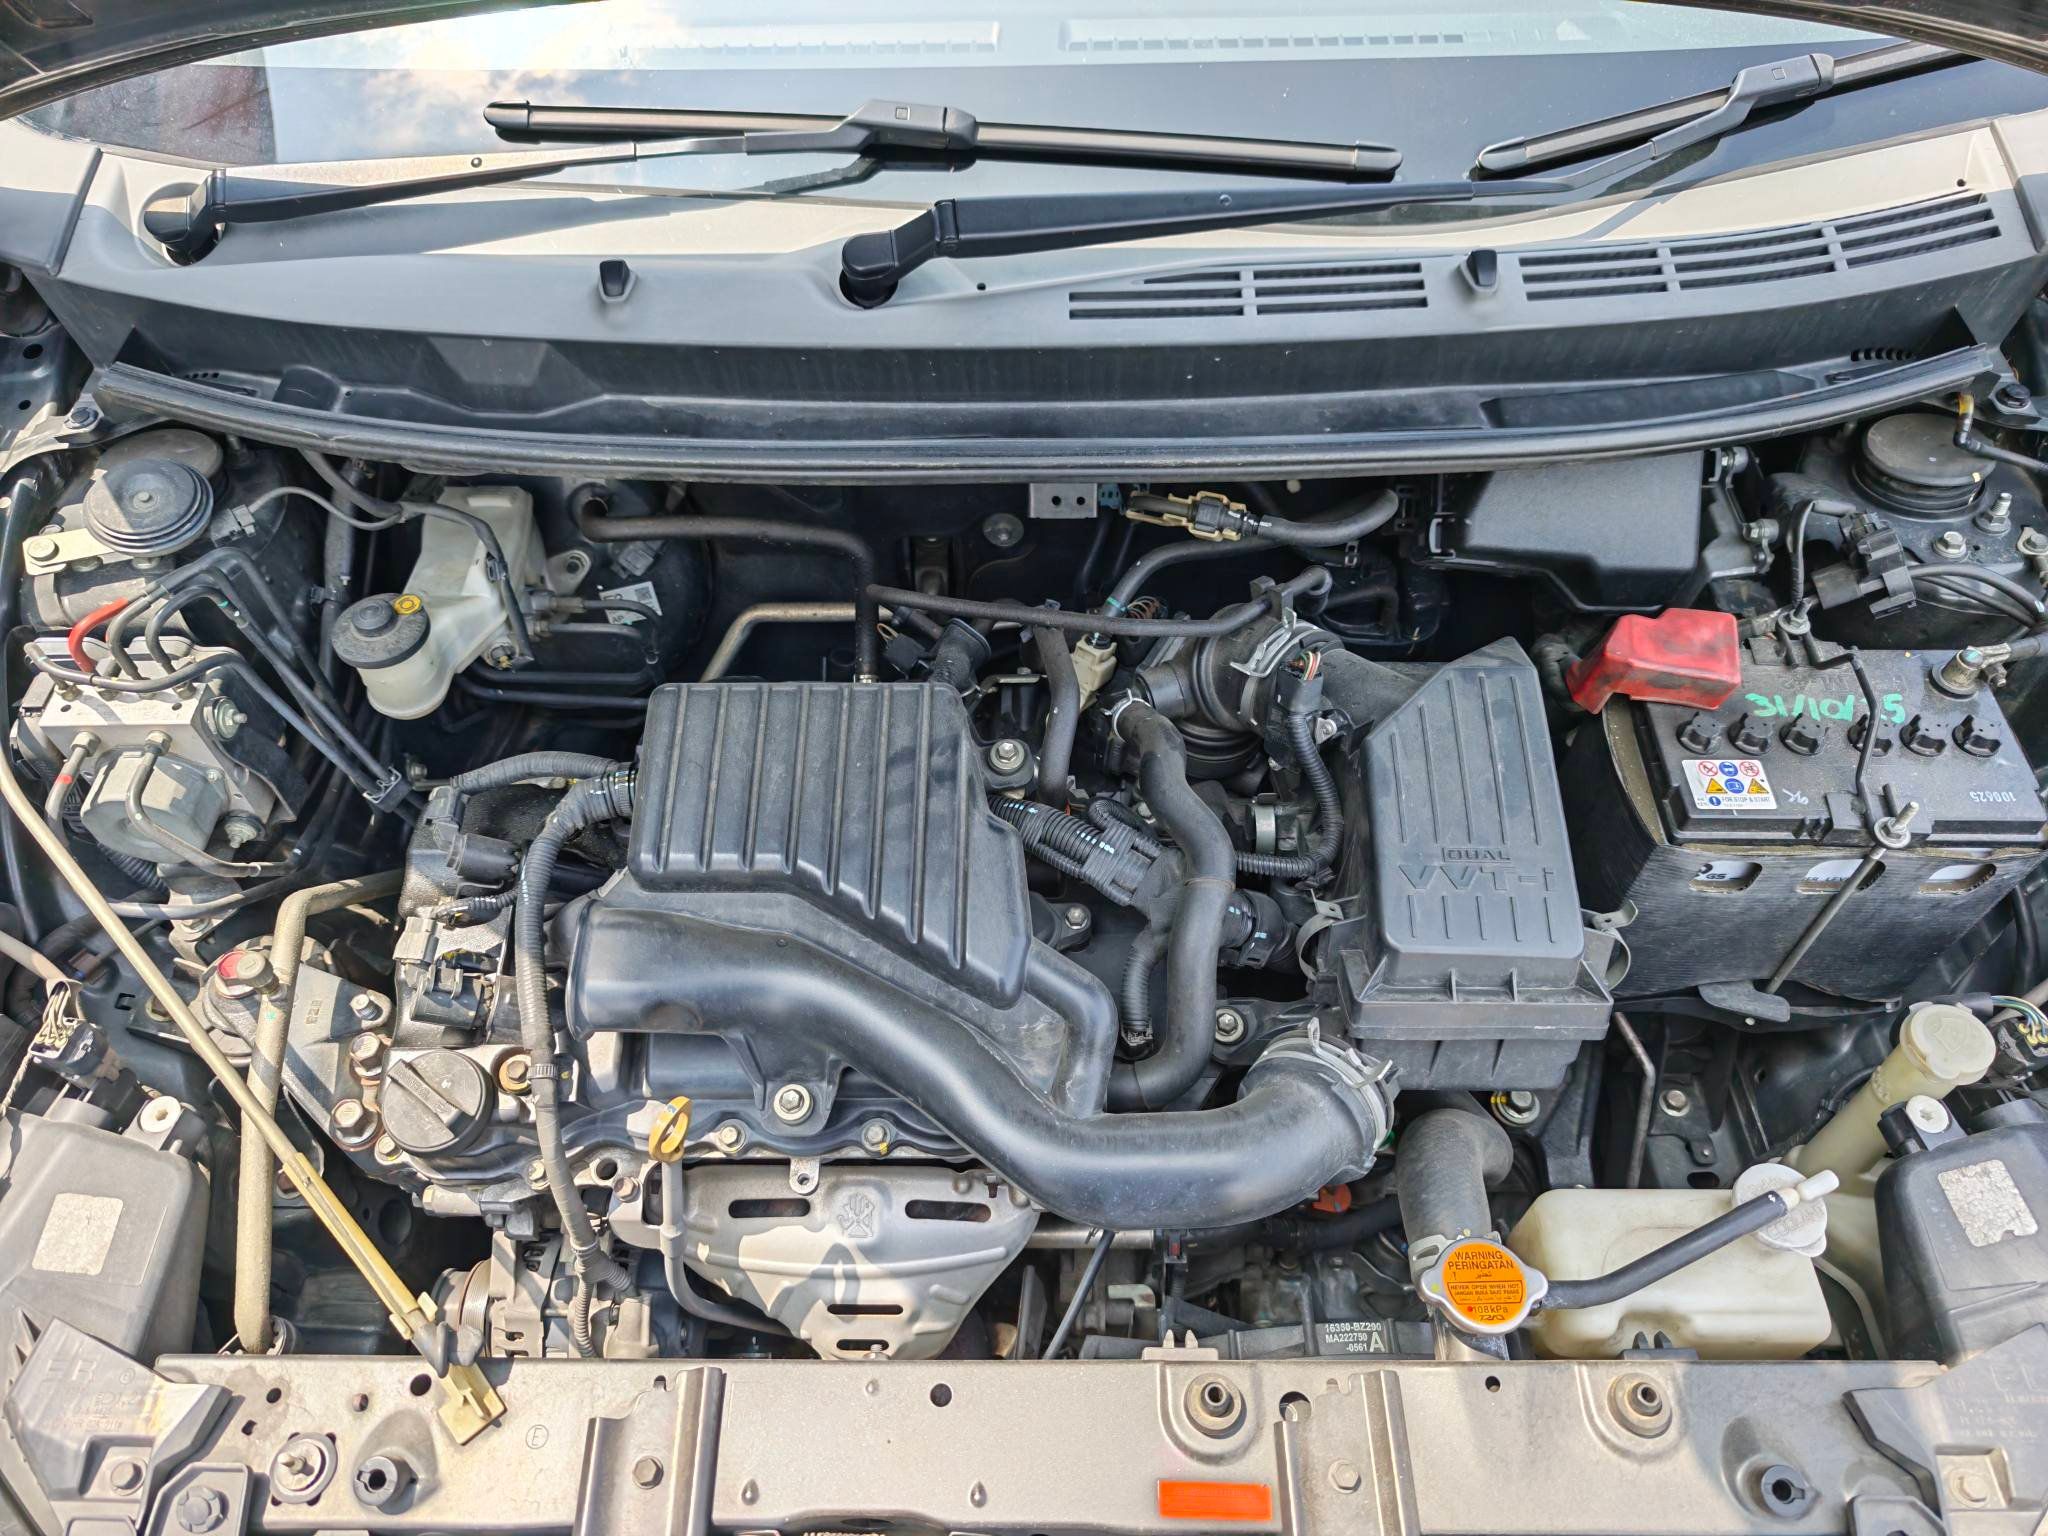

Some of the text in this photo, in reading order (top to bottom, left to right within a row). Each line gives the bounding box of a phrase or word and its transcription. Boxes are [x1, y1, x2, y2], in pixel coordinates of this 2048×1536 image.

[1447, 848, 1512, 861] DUAL
[1398, 863, 1556, 892] VVT-i
[1455, 1251, 1503, 1260] WARNING
[1448, 1260, 1515, 1270] PERINGATAN
[1325, 1332, 1368, 1344] MA222750
[1369, 1331, 1386, 1352] A
